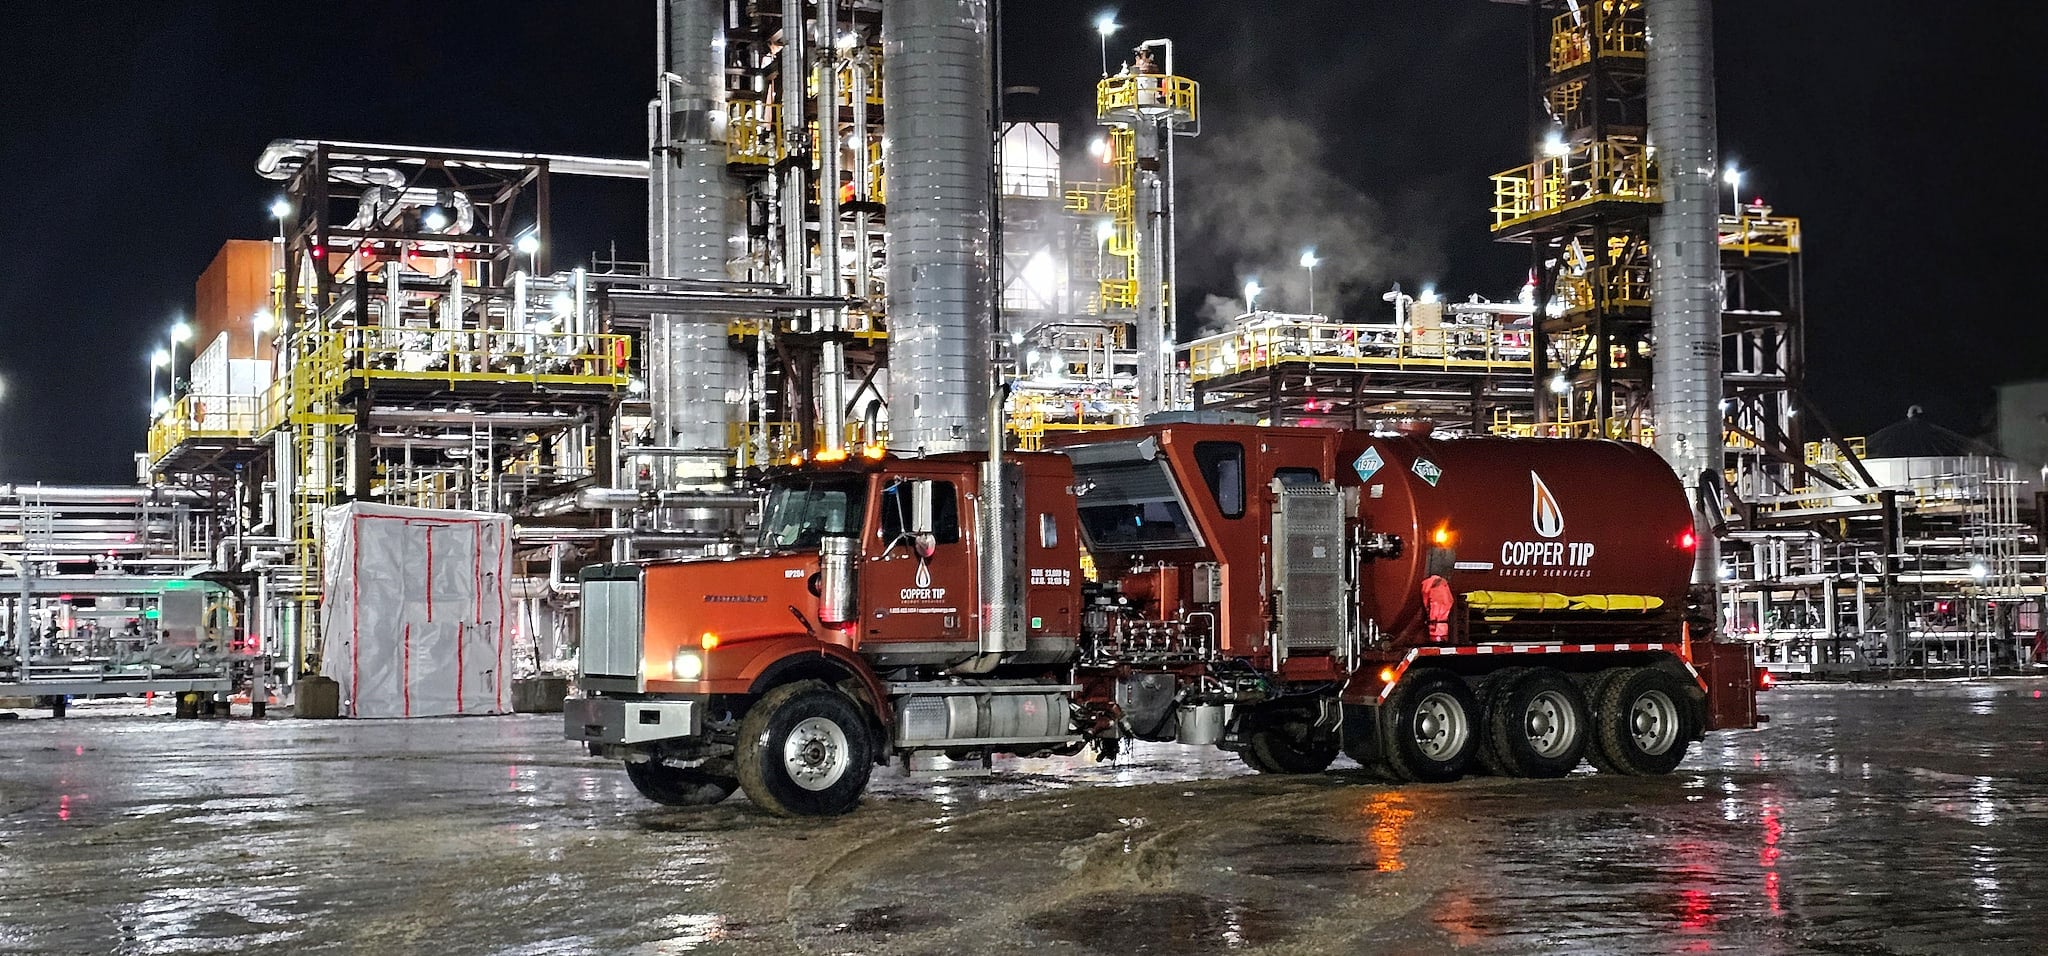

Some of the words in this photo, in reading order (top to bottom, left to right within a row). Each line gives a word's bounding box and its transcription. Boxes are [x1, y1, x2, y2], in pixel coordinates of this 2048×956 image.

[1357, 459, 1377, 471] 1977
[1501, 541, 1564, 566] COPPER
[1568, 542, 1595, 566] TIP
[1499, 568, 1537, 577] ENERGY
[1542, 569, 1592, 578] SERVICES
[900, 588, 931, 600] COPPER
[932, 588, 945, 600] TIP
